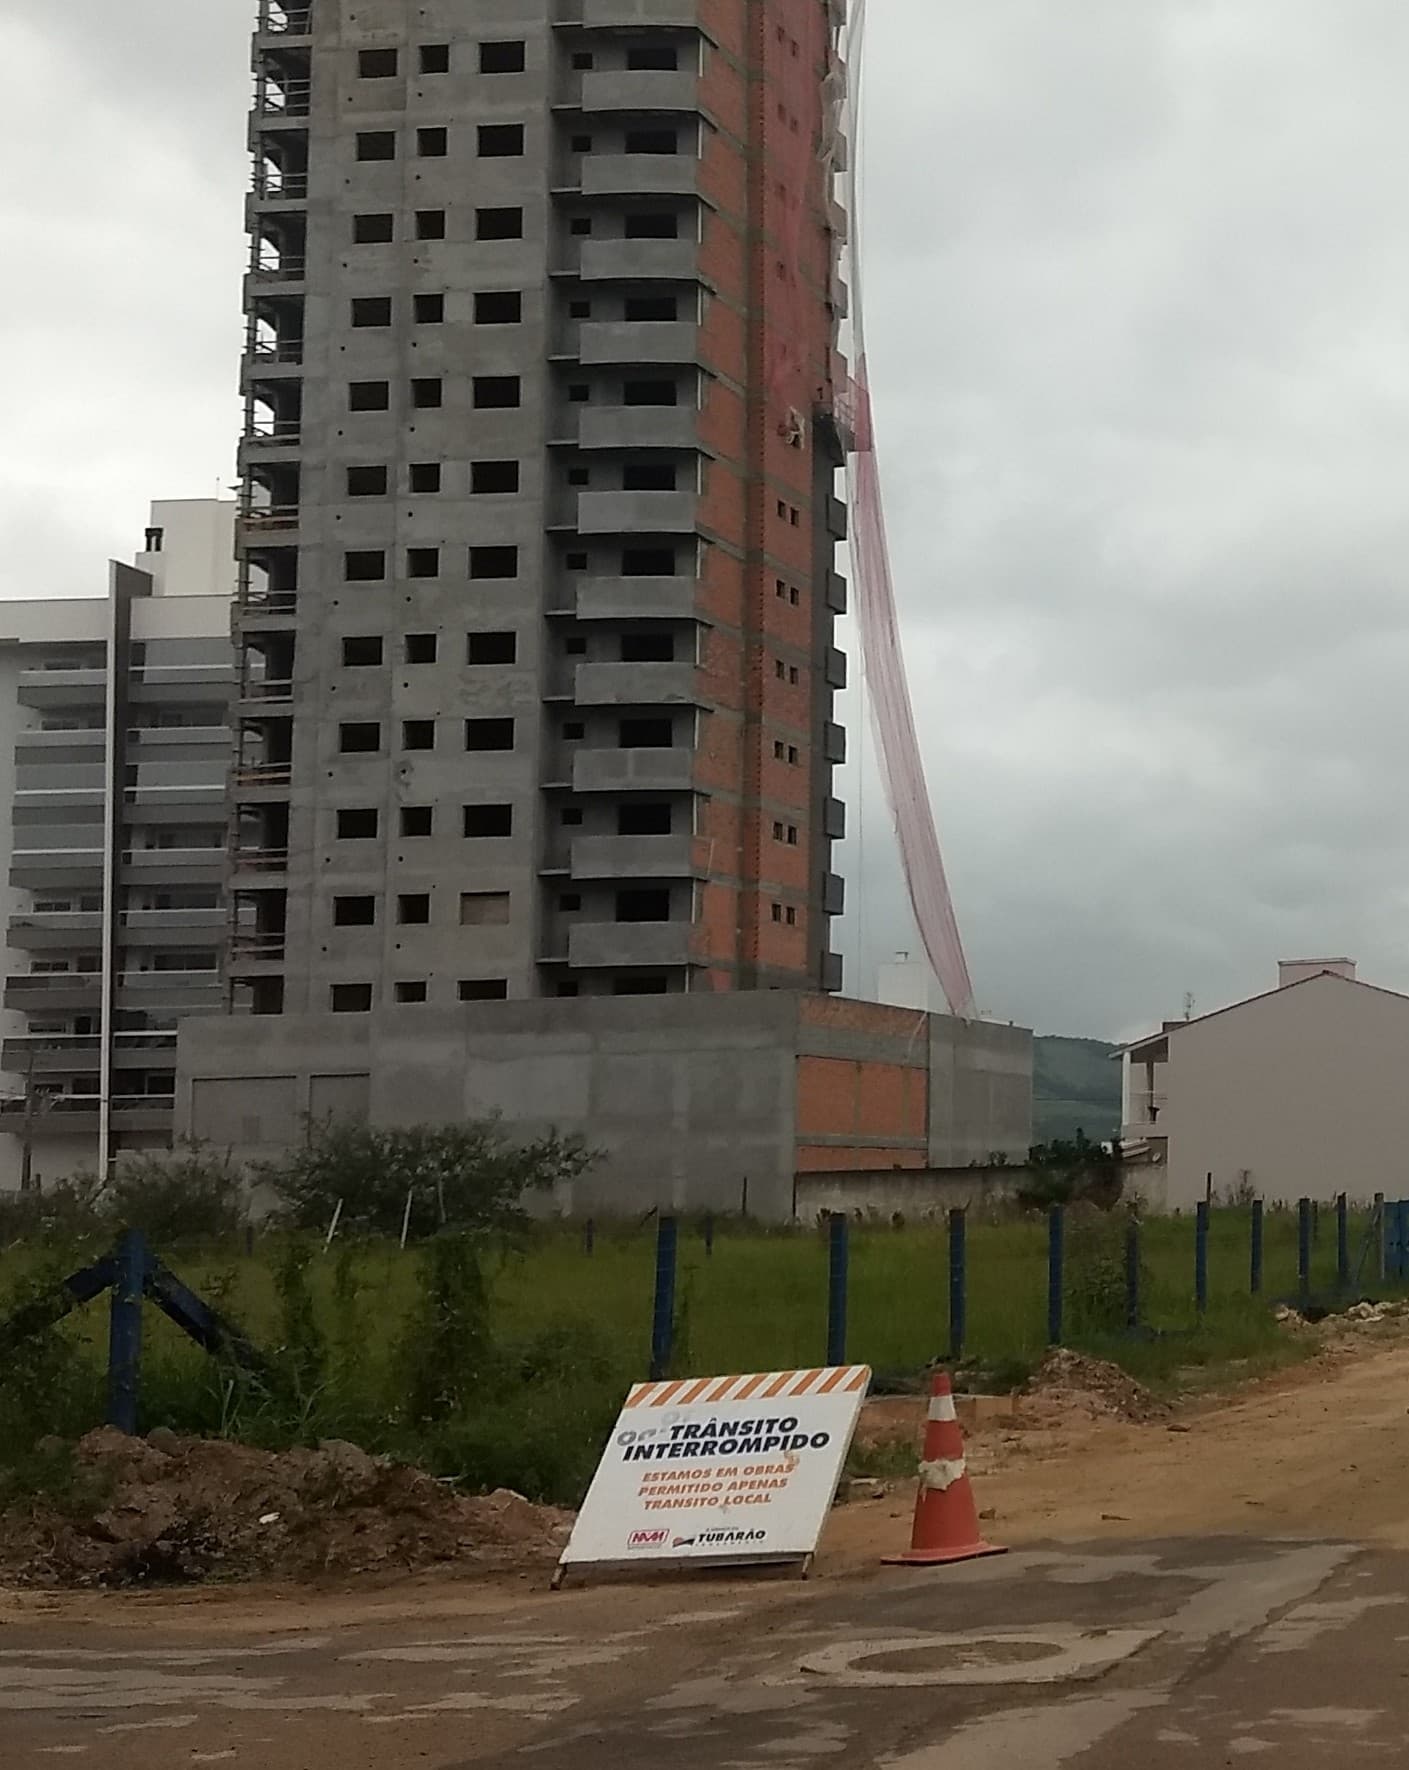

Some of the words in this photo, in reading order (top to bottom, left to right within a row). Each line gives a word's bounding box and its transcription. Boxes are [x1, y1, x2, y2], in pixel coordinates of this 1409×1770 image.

[670, 1416, 799, 1441] TRÂNSITO
[623, 1431, 830, 1462] INTERROMPIDO
[642, 1468, 713, 1483] ESTAMOS
[716, 1466, 738, 1478] EM
[743, 1463, 796, 1477] OBRAS
[638, 1482, 723, 1497] PERMITIDO
[727, 1478, 789, 1492] APENAS
[644, 1497, 719, 1511] TRANSITO
[723, 1493, 772, 1506] LOCAL
[698, 1528, 766, 1542] TUBARÃO
